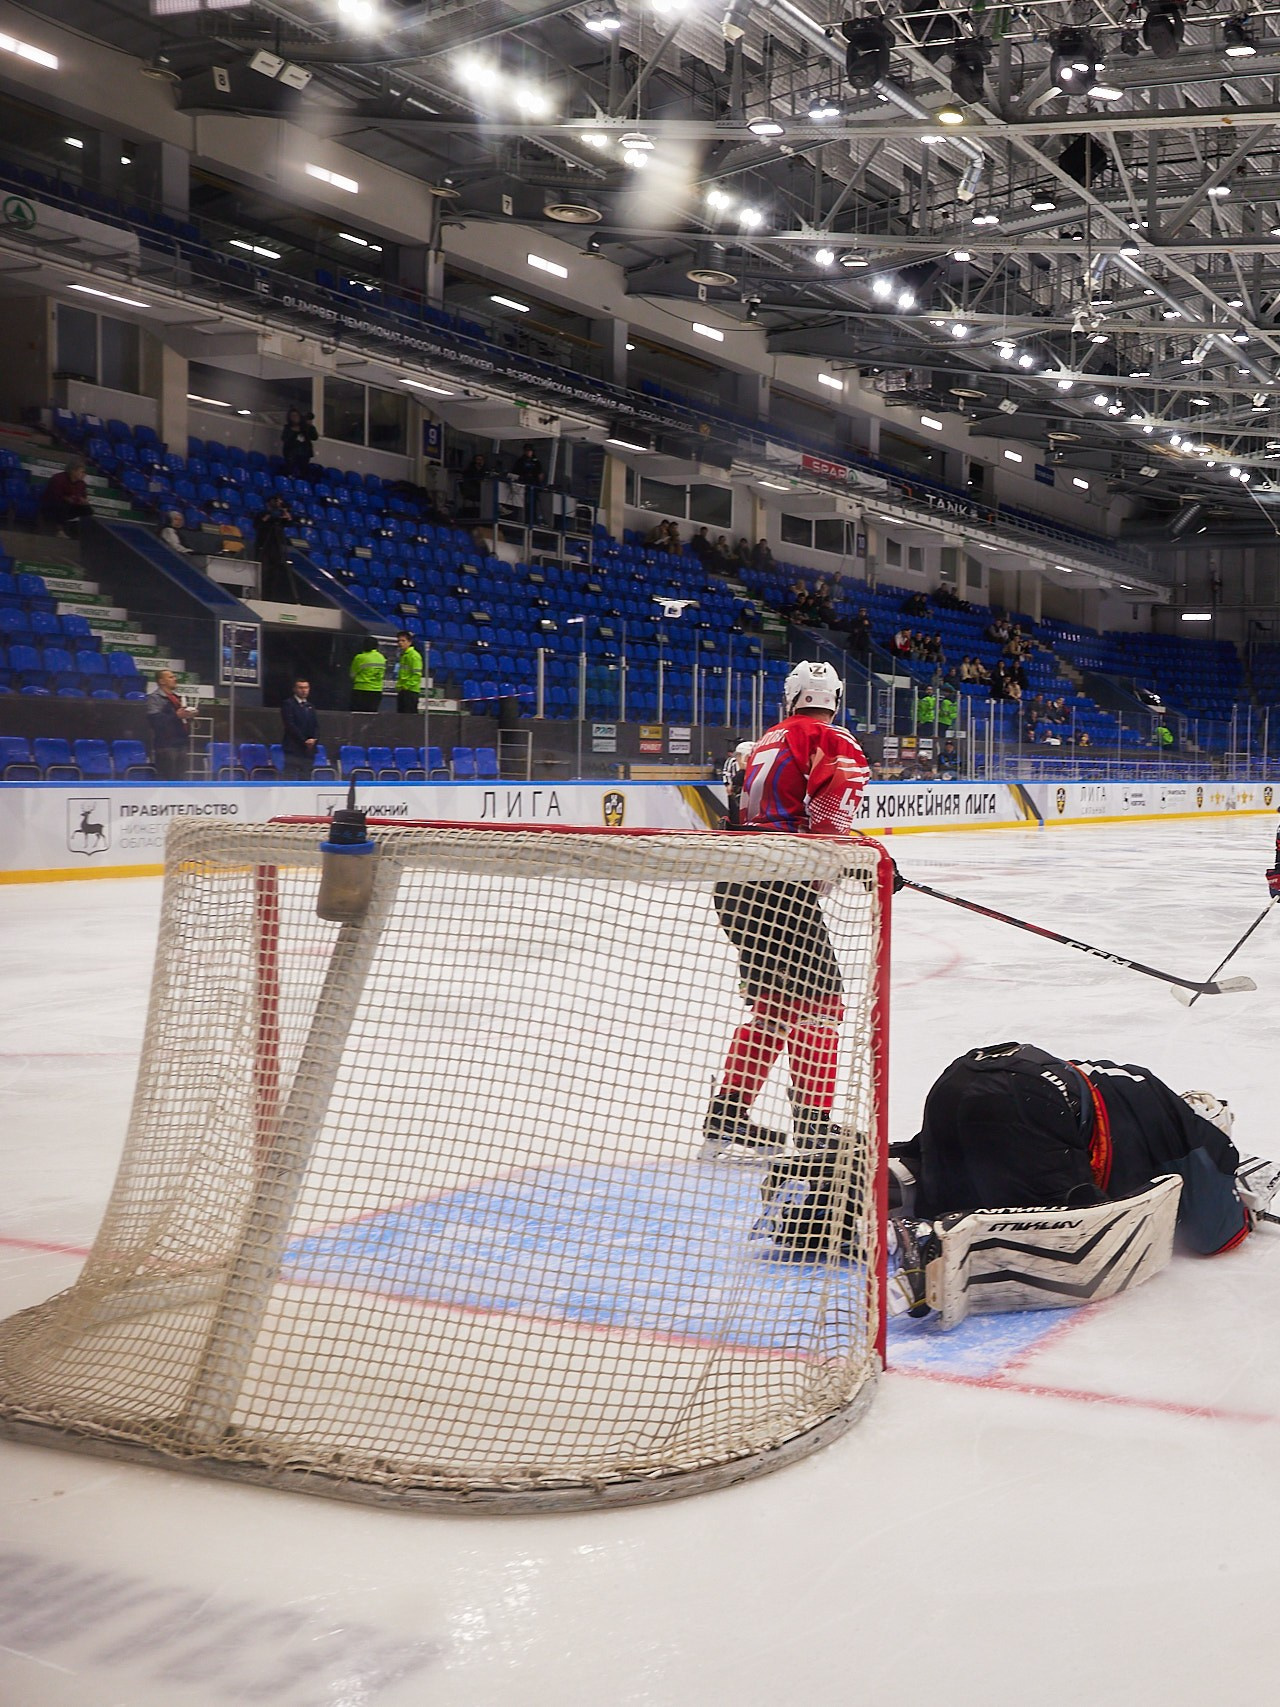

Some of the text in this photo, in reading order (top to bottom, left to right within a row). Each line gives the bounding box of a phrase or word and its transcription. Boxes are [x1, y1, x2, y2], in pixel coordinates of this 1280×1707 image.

[428, 427, 438, 446] 9
[811, 461, 848, 481] SPAR
[120, 804, 239, 817] ПРАВИТЕЛЬСТВО
[481, 791, 562, 819] ЛИГА
[877, 788, 960, 818] ХОККЕЙНАЯ
[965, 794, 996, 815] ЛИГА
[1065, 940, 1132, 967] CCM
